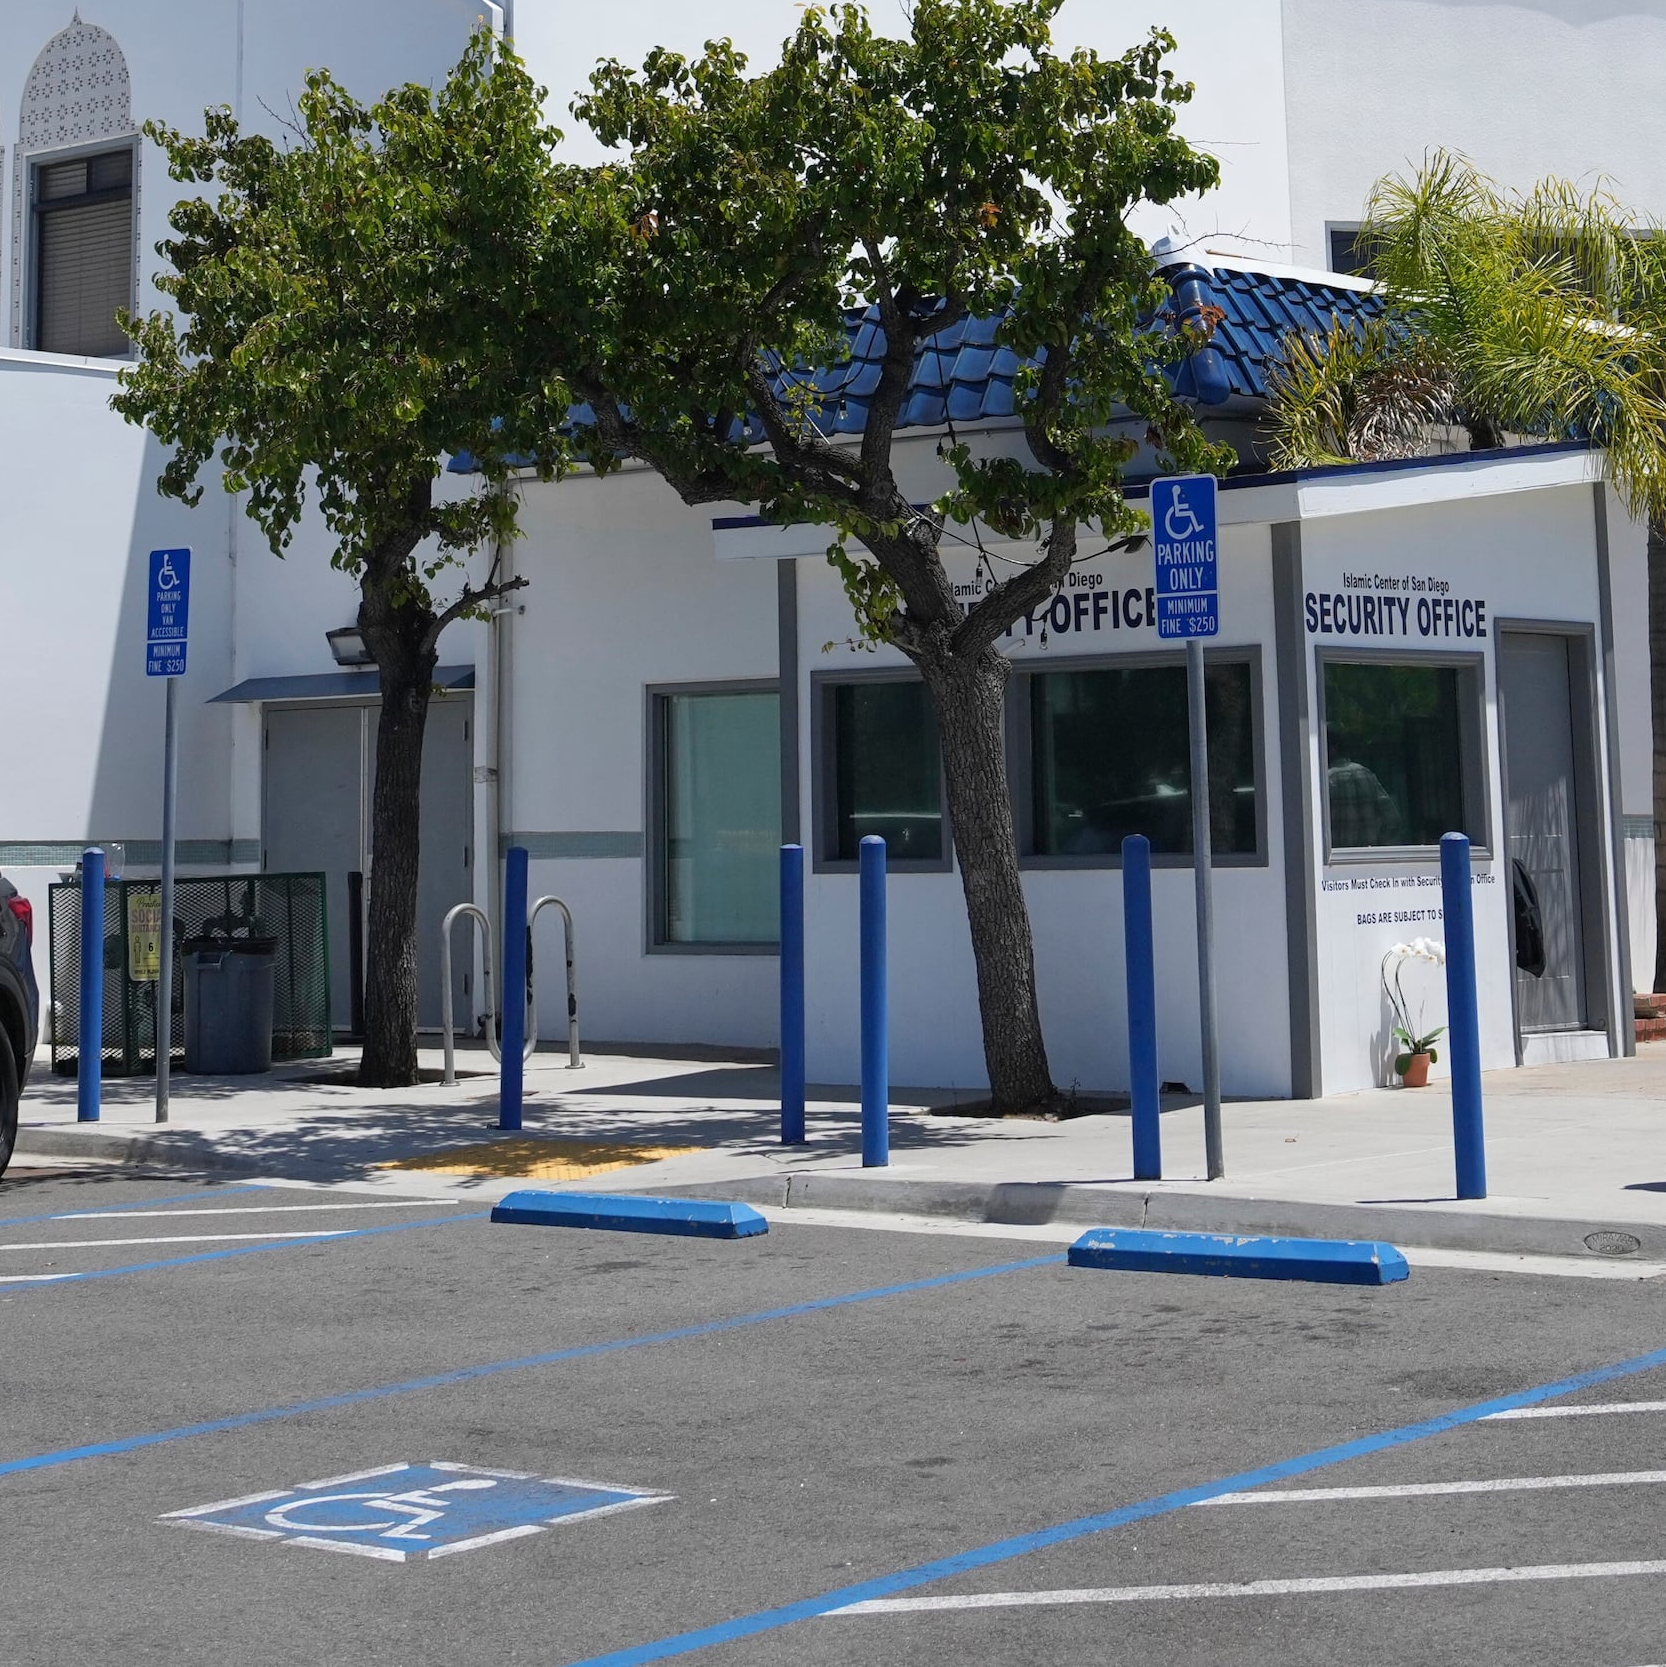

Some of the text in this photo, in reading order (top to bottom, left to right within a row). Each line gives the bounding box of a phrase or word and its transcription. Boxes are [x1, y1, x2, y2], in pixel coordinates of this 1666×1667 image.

[1157, 540, 1214, 566] PARKING
[1069, 572, 1103, 590] Diego
[1169, 566, 1204, 591] ONLY
[1343, 572, 1450, 596] Islamic Center of San Diego
[156, 590, 181, 602] PARKING
[161, 603, 176, 614] ONLY
[1050, 587, 1156, 634] OFFICE
[1167, 597, 1208, 615] MINIMUM
[1305, 592, 1487, 638] SECURITY OFFICE
[162, 615, 174, 625] VAN
[1161, 615, 1215, 634] FINE $250
[151, 626, 184, 638] ACCESSIBLE
[153, 644, 181, 657] MINIMUM
[148, 659, 185, 673] FINE $250
[1322, 881, 1349, 892] Visitors
[1351, 879, 1368, 890] Must
[1370, 878, 1391, 890] Check
[1392, 878, 1399, 888] In
[1401, 877, 1416, 887] with
[1476, 873, 1495, 885] Office
[1357, 913, 1377, 925] BAGS
[1378, 911, 1392, 924] ARE
[1393, 909, 1425, 922] SUBJECT
[1427, 909, 1437, 920] TO
[148, 942, 154, 952] 6
